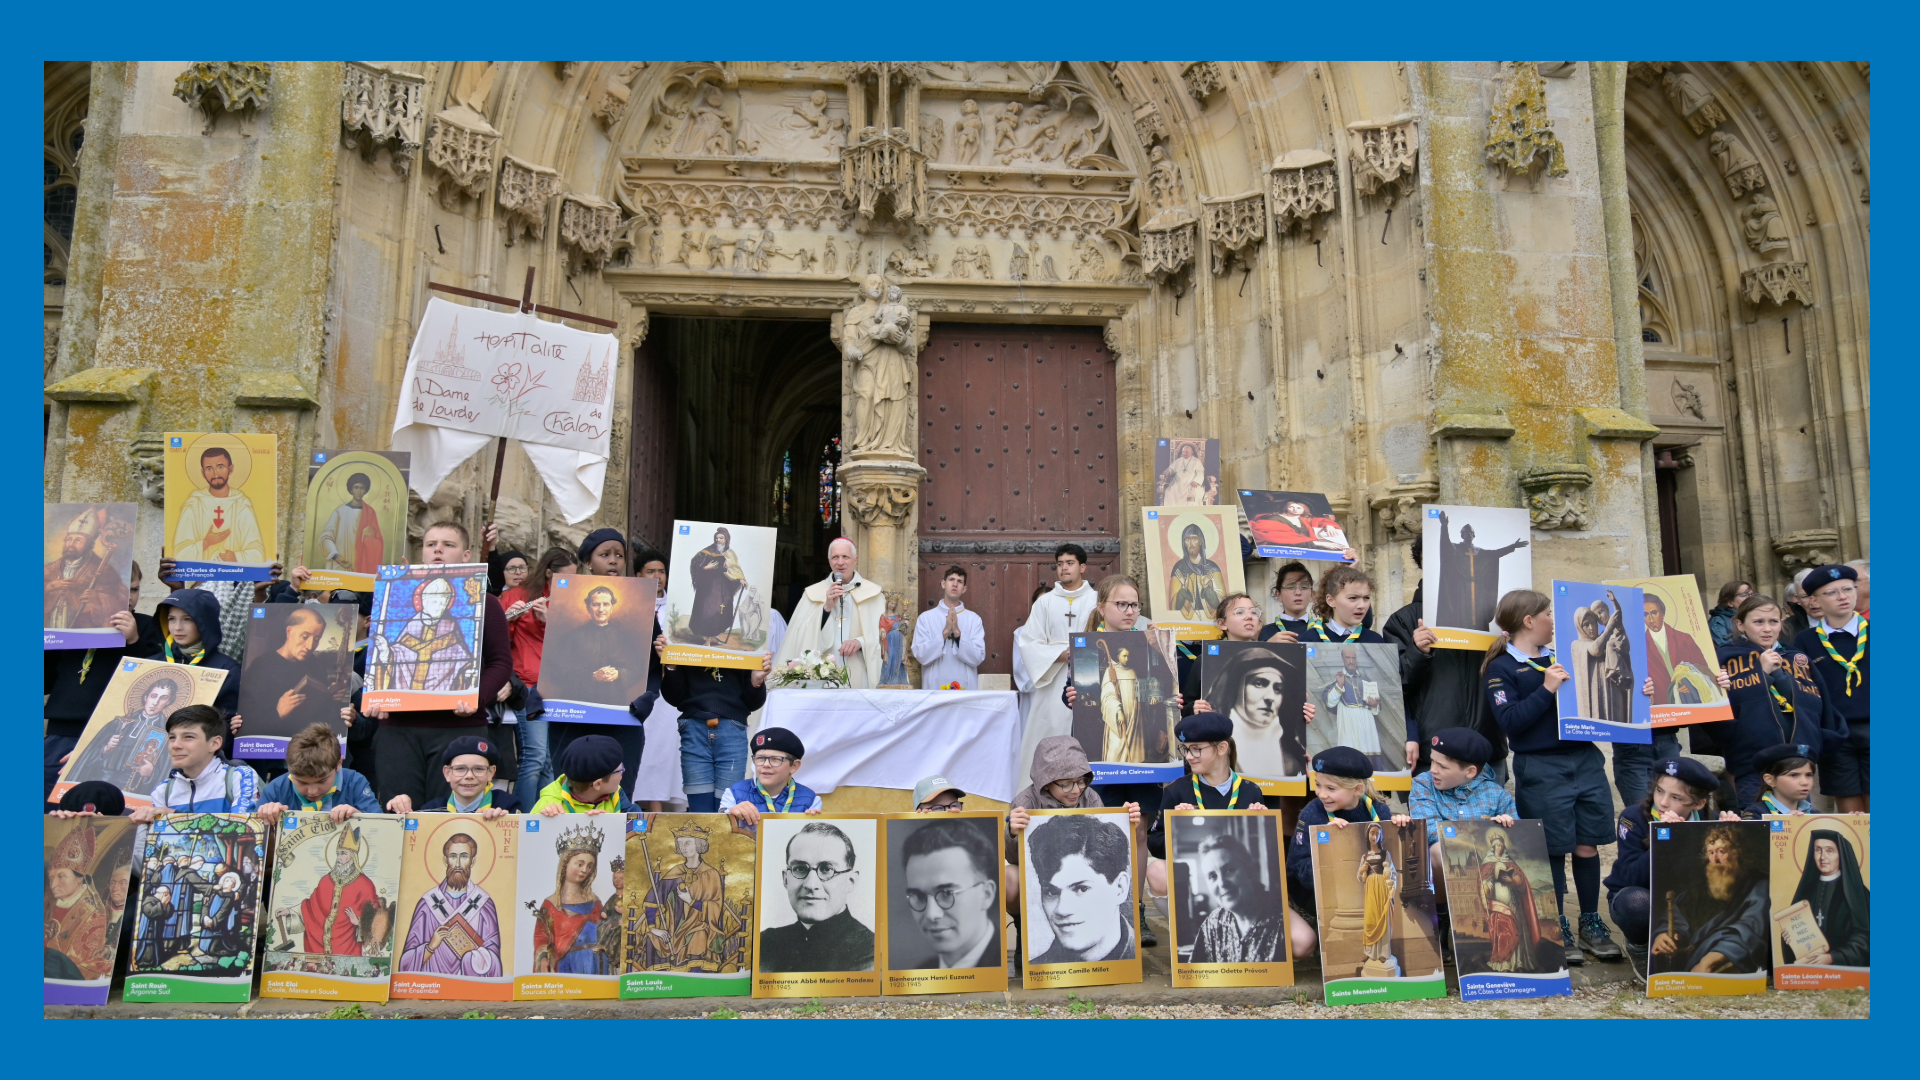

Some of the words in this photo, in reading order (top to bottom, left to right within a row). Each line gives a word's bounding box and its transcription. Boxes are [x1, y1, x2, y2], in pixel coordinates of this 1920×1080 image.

[428, 399, 480, 423] Lourdes
[590, 409, 602, 420] de
[411, 981, 441, 989] Augustin
[130, 988, 157, 996] Argonne
[1352, 987, 1387, 995] Menehould
